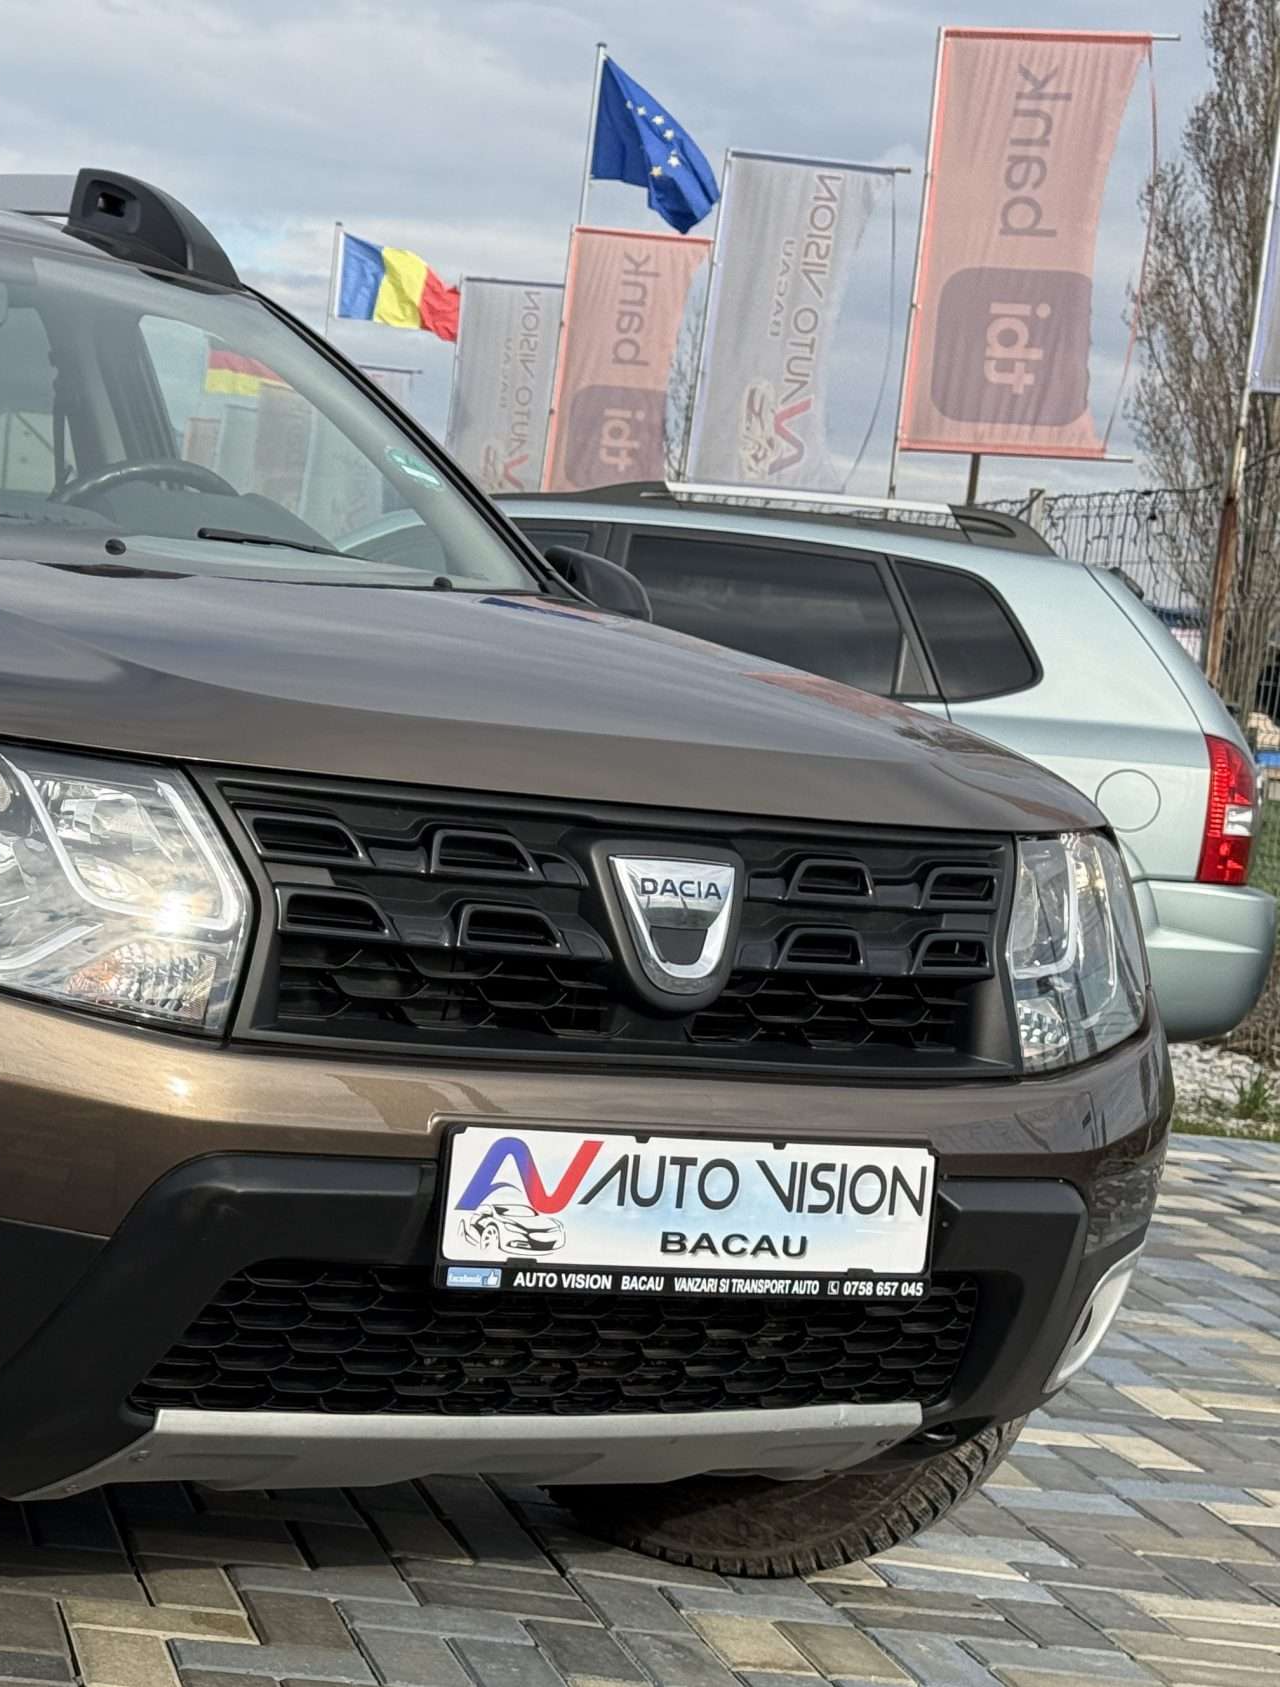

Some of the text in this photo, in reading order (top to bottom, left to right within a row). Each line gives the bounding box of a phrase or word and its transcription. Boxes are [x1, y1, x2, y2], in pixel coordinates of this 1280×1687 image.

[640, 877, 722, 900] DACIA
[577, 1153, 928, 1217] AUTO VISION
[660, 1231, 808, 1258] BACAU
[513, 1271, 924, 1297] AUTO VISION BACAU VANZARI SI TRANSPORT AUTO 0758 657 045
